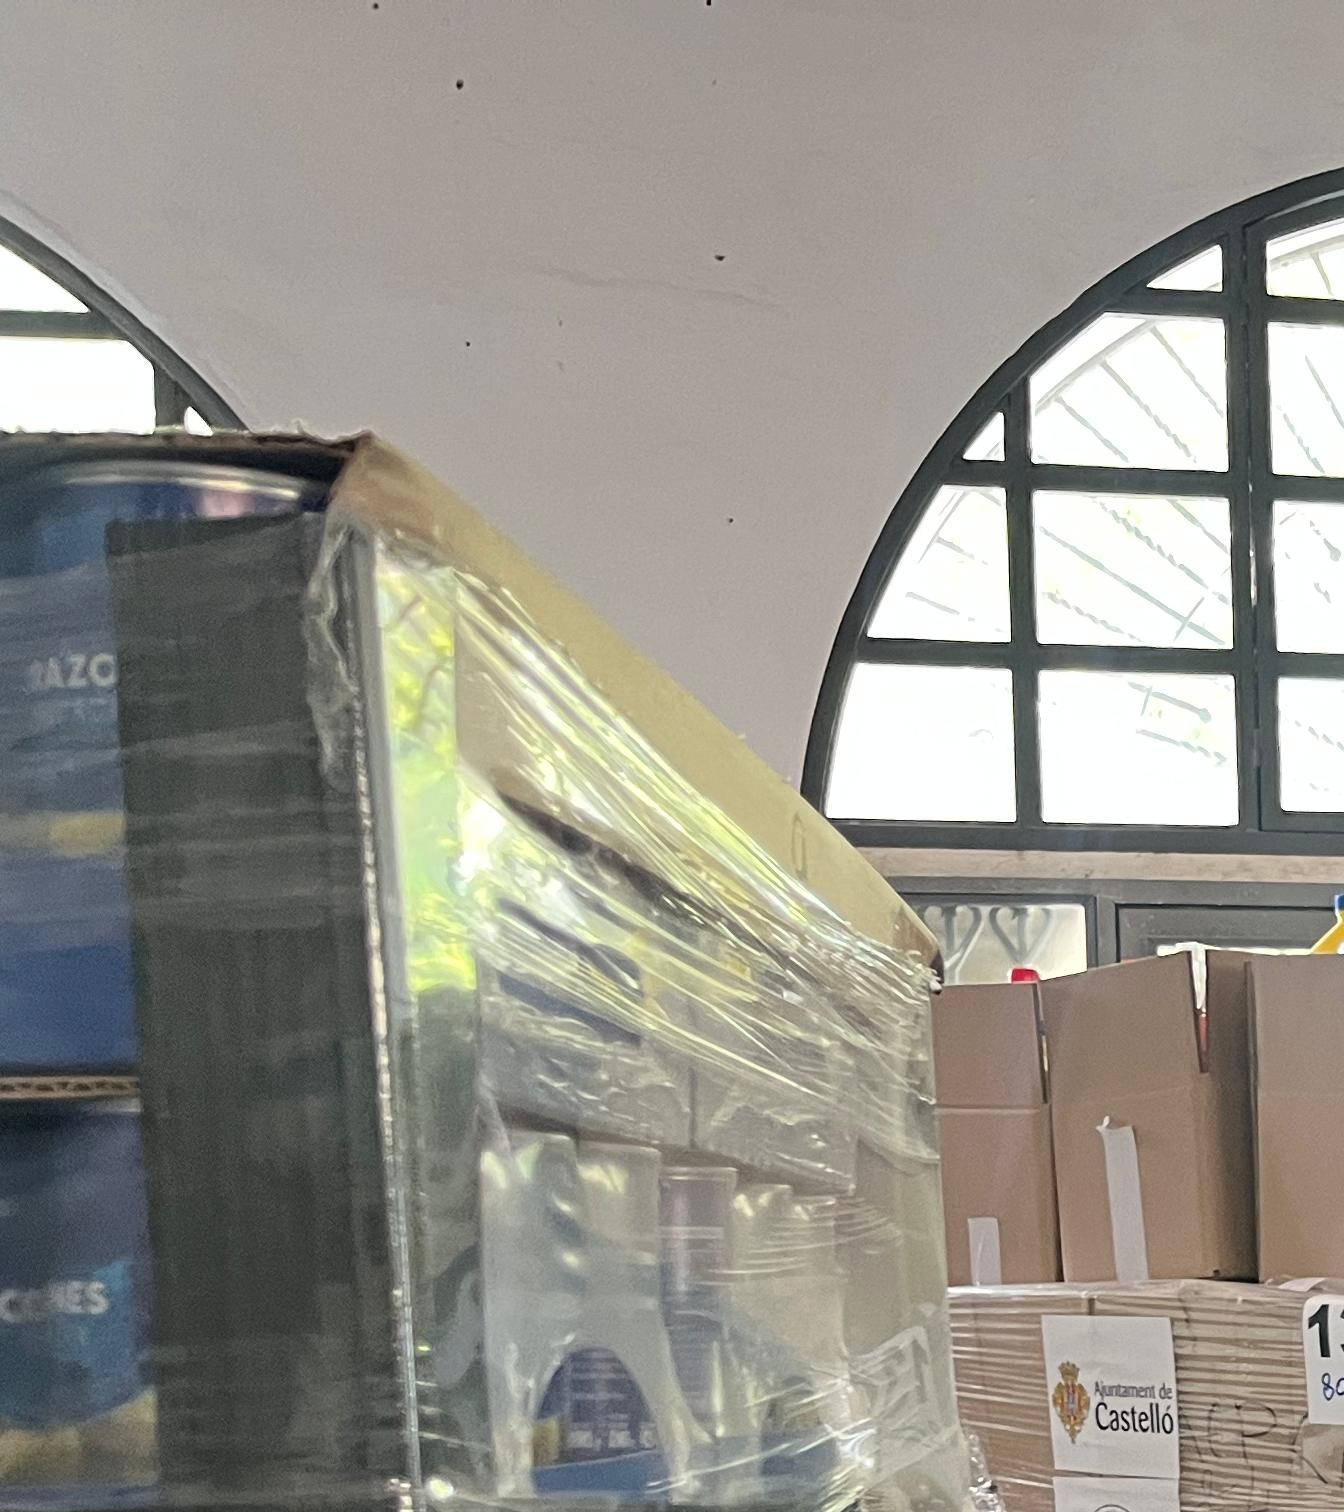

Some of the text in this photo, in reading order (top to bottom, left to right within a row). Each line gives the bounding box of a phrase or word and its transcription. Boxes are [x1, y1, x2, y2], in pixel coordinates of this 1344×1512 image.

[1094, 1380, 1173, 1400] Ajuntament de
[1095, 1402, 1174, 1434] Castelló
